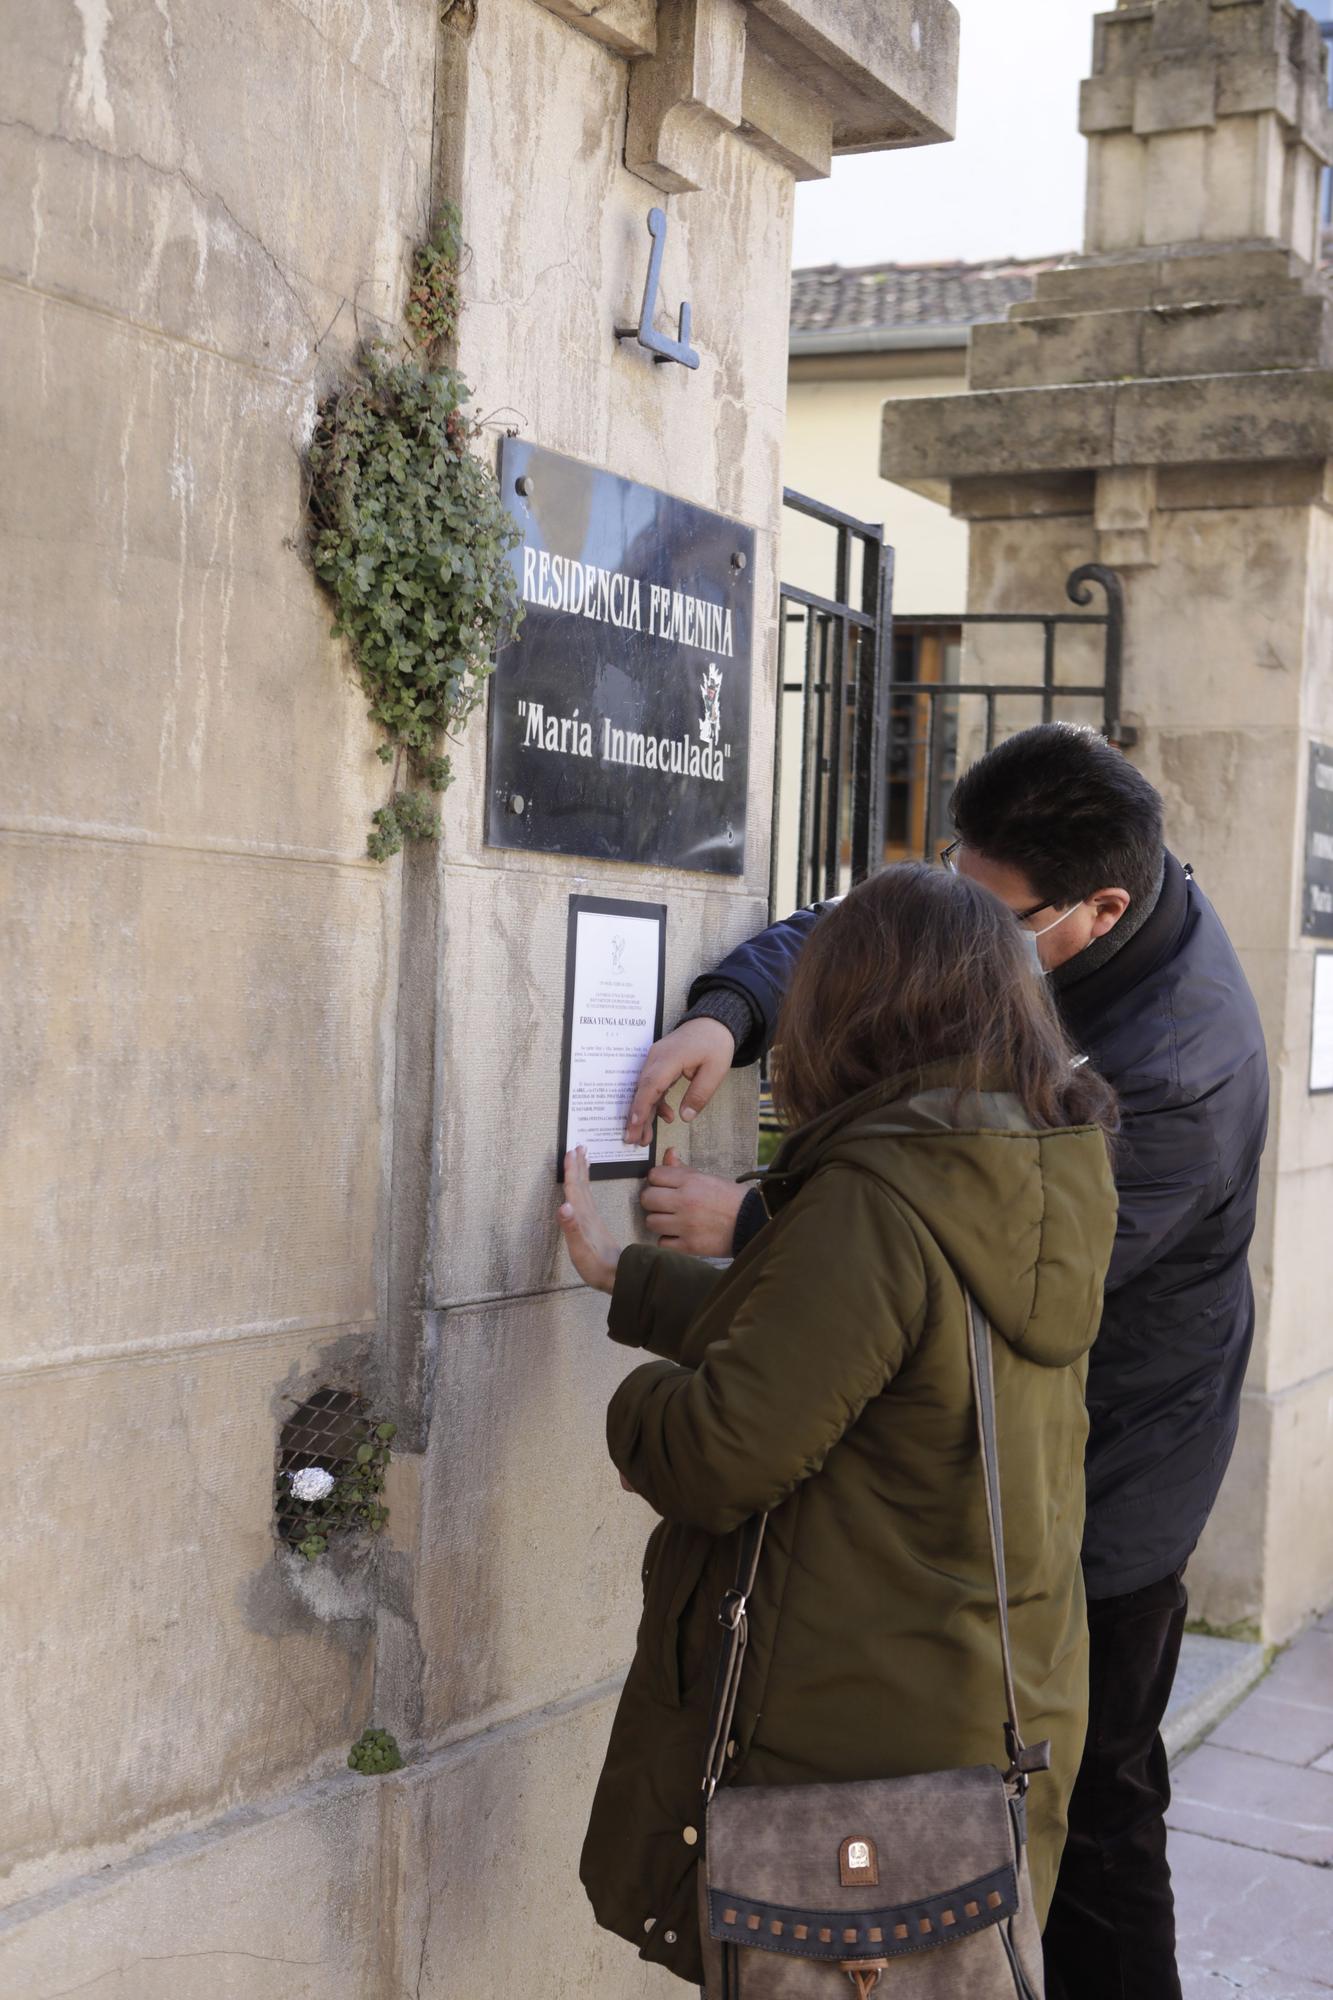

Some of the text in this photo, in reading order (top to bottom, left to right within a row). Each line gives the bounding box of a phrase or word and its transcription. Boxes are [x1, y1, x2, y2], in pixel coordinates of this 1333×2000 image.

[523, 546, 734, 657] RESIDENCIA FEMENINA
[518, 700, 731, 781] "María Inmaculada"
